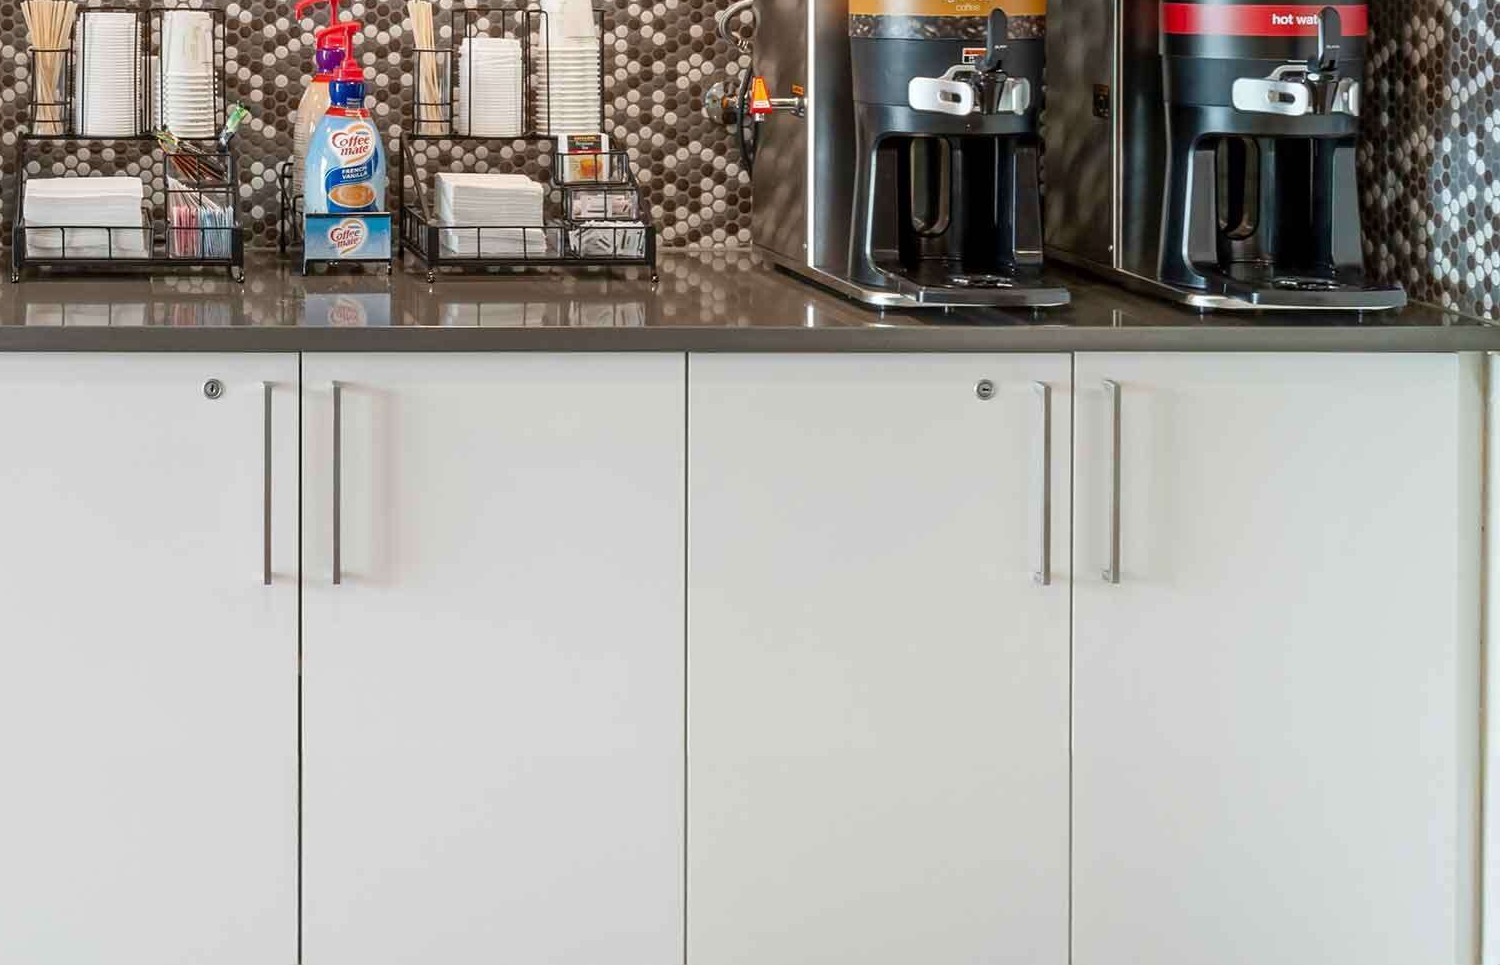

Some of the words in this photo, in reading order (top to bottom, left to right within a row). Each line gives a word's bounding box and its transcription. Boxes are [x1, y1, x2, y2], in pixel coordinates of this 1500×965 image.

[1272, 13, 1294, 25] hot
[1296, 14, 1318, 25] wat
[332, 132, 370, 148] Coffee
[340, 145, 369, 156] mate
[330, 227, 361, 242] Coffee
